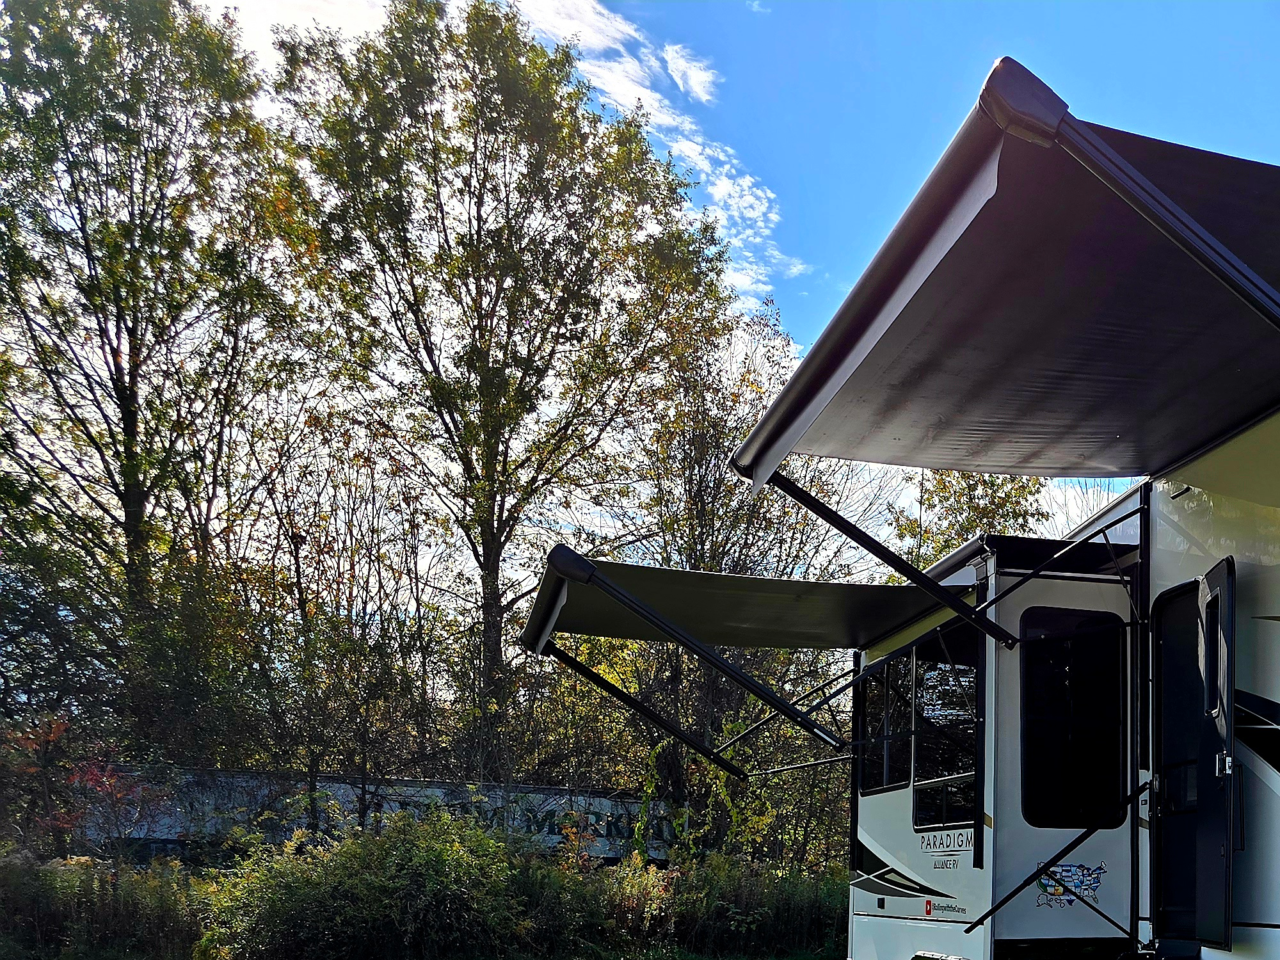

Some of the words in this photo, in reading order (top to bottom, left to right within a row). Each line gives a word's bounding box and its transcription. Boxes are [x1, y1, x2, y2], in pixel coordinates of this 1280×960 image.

[920, 831, 974, 850] PARADIGM
[933, 859, 952, 870] ALLIANCE
[952, 859, 959, 870] RV
